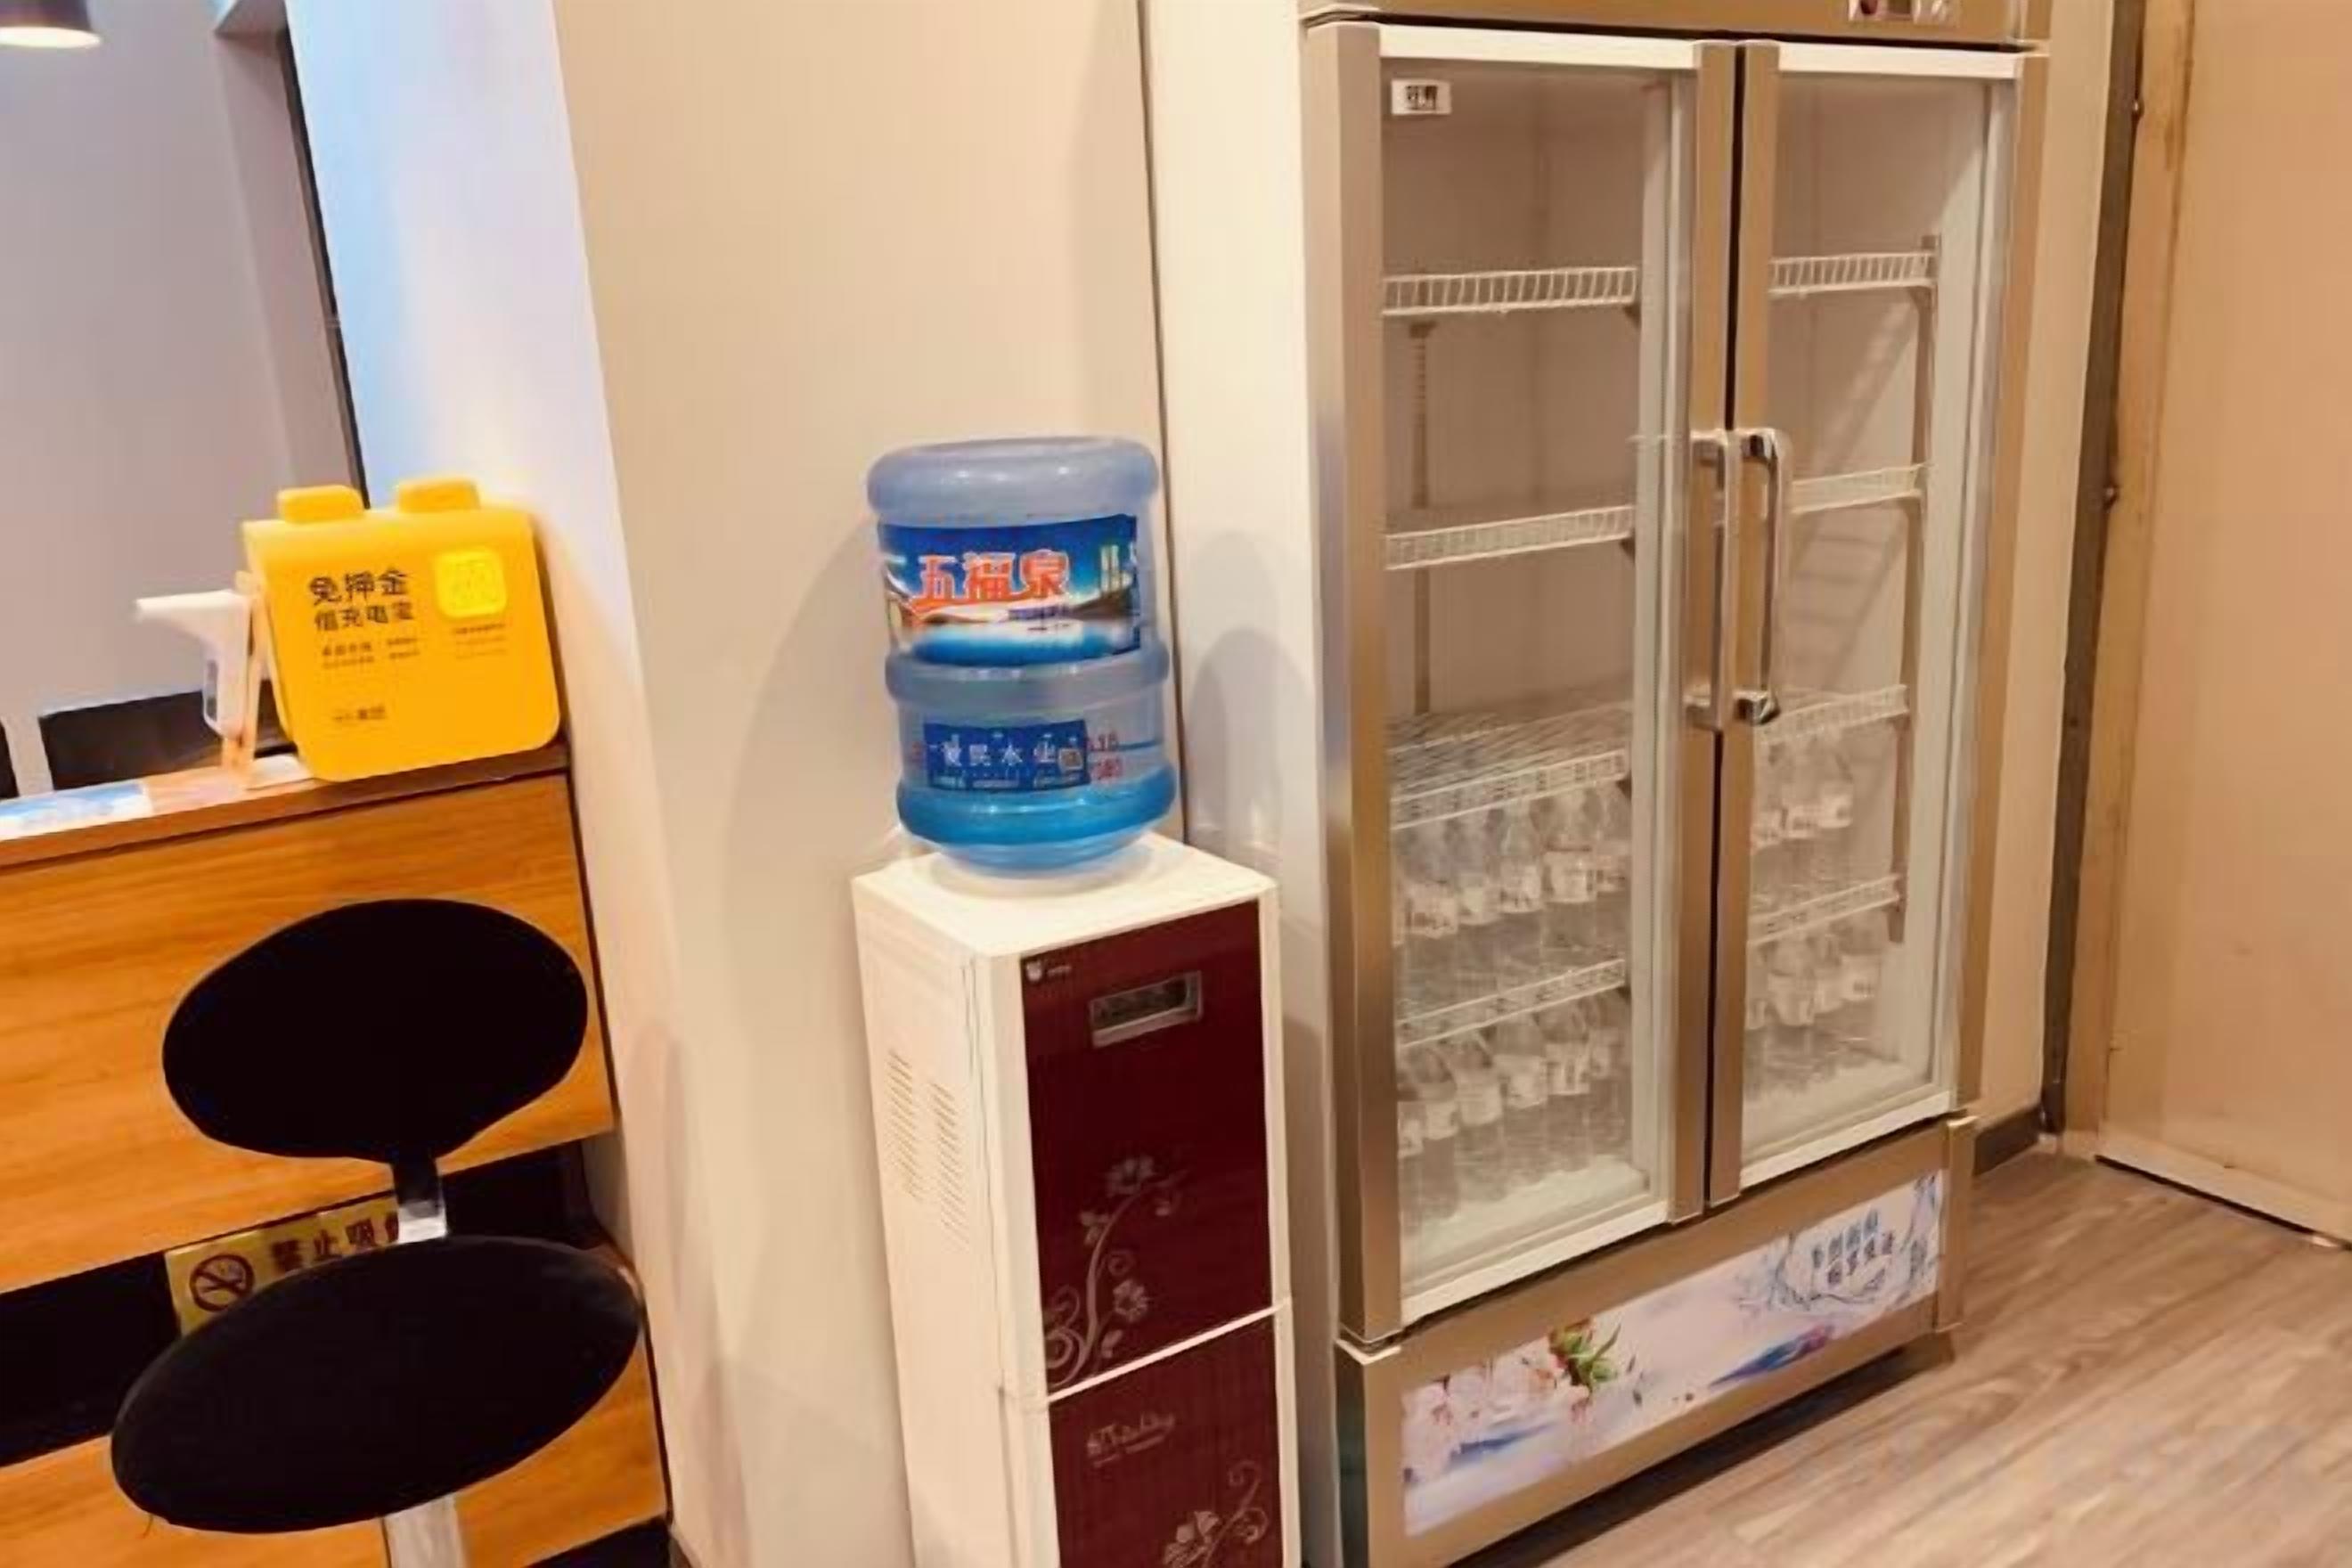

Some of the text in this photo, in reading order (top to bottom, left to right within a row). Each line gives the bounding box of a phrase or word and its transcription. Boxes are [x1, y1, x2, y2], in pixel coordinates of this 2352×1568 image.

[308, 568, 411, 606] 免押金
[914, 548, 1070, 604] 五福泉
